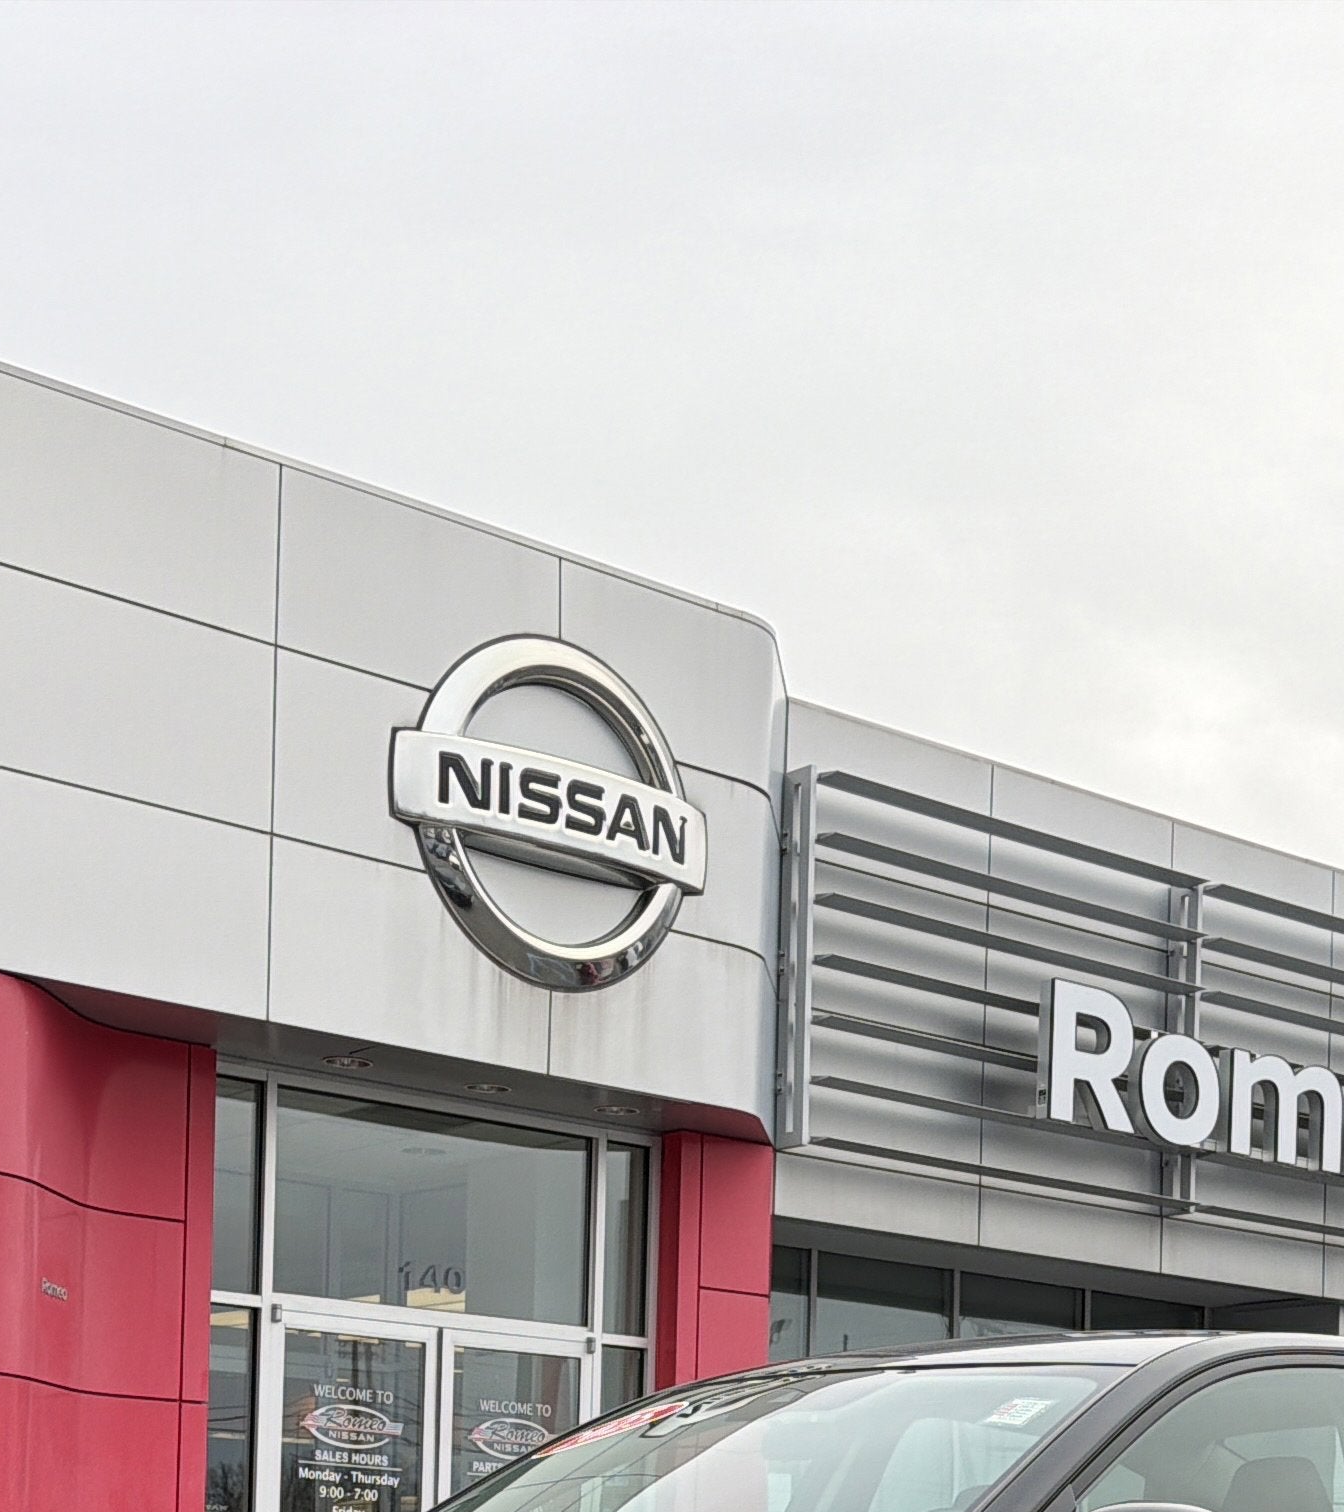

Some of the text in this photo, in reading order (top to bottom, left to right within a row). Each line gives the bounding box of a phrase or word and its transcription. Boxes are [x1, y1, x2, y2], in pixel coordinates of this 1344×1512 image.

[438, 751, 688, 865] NISSAN
[398, 1261, 465, 1294] 140
[313, 1384, 394, 1405] WELCOME TO
[479, 1399, 552, 1417] WELCOME TO
[321, 1407, 387, 1432] Romeo
[328, 1430, 375, 1443] NISSAN
[485, 1421, 546, 1442] Romeo
[314, 1450, 389, 1467] SALES HOURS
[298, 1467, 342, 1484] Monday
[351, 1471, 400, 1488] Thursday
[319, 1486, 344, 1499] 9:00
[354, 1488, 378, 1501] 7:00
